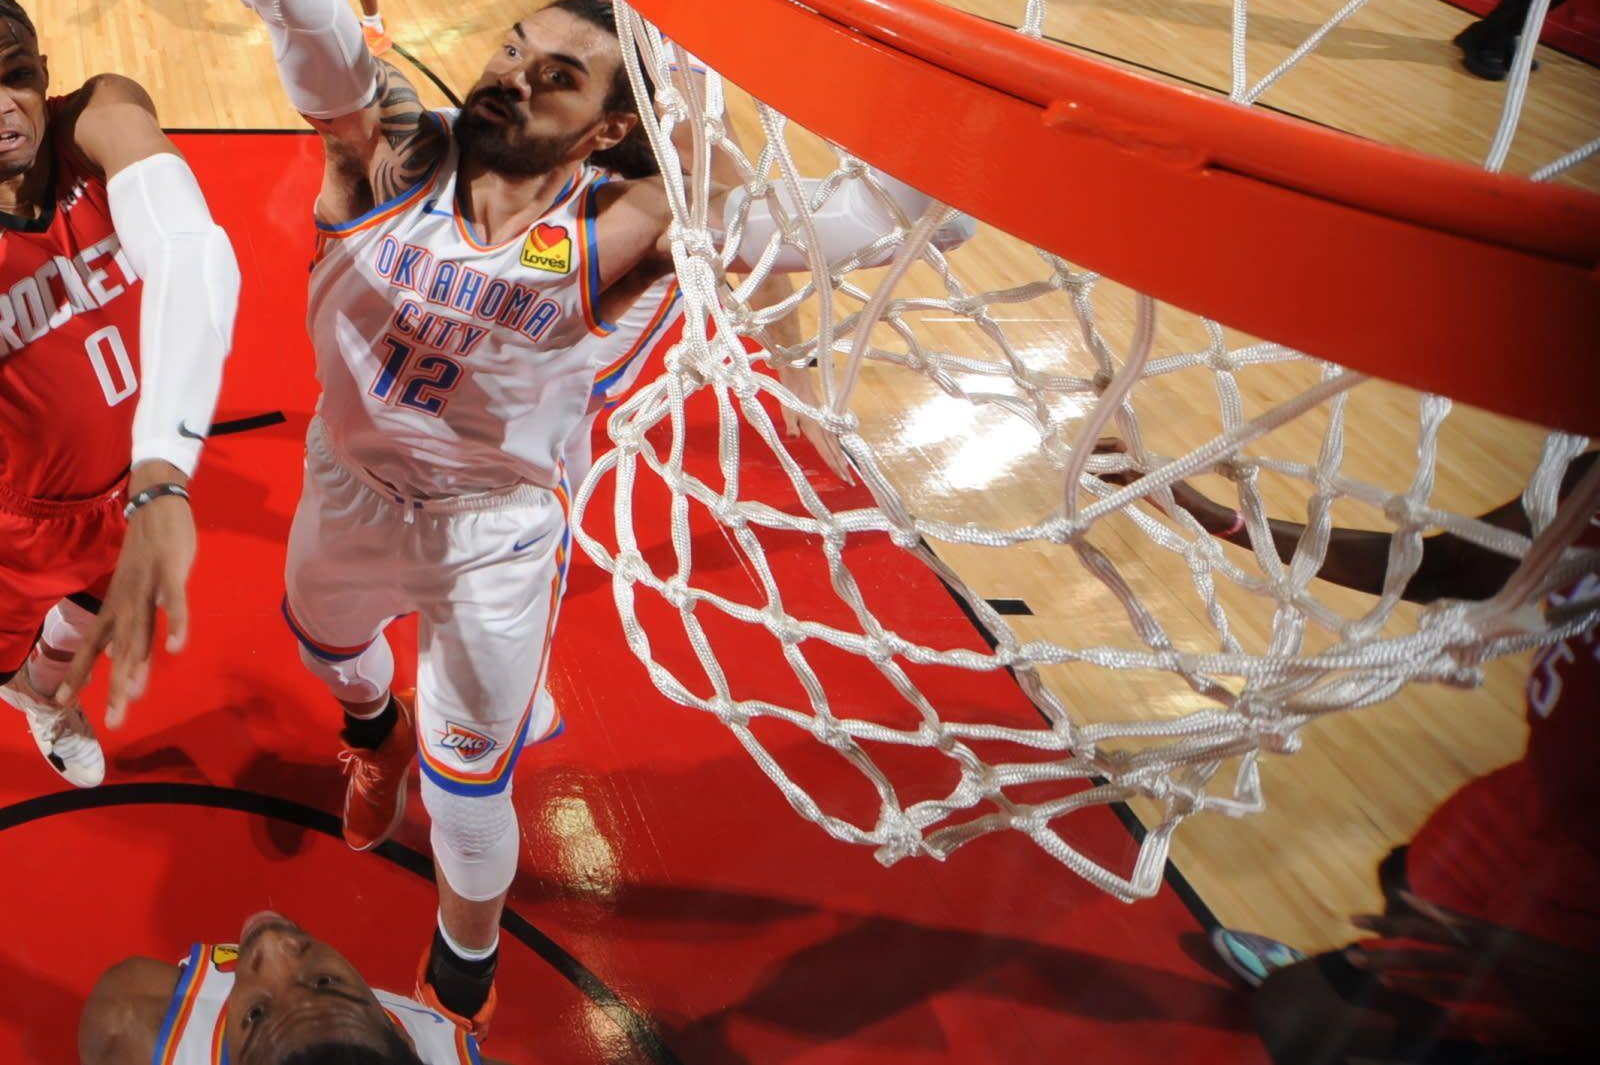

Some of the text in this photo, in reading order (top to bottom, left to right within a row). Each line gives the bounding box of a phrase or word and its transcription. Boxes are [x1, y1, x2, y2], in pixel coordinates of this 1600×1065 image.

[375, 234, 561, 344] OKLAHOMA
[391, 298, 490, 357] CITY
[84, 324, 139, 408] 0
[367, 332, 464, 419] 12
